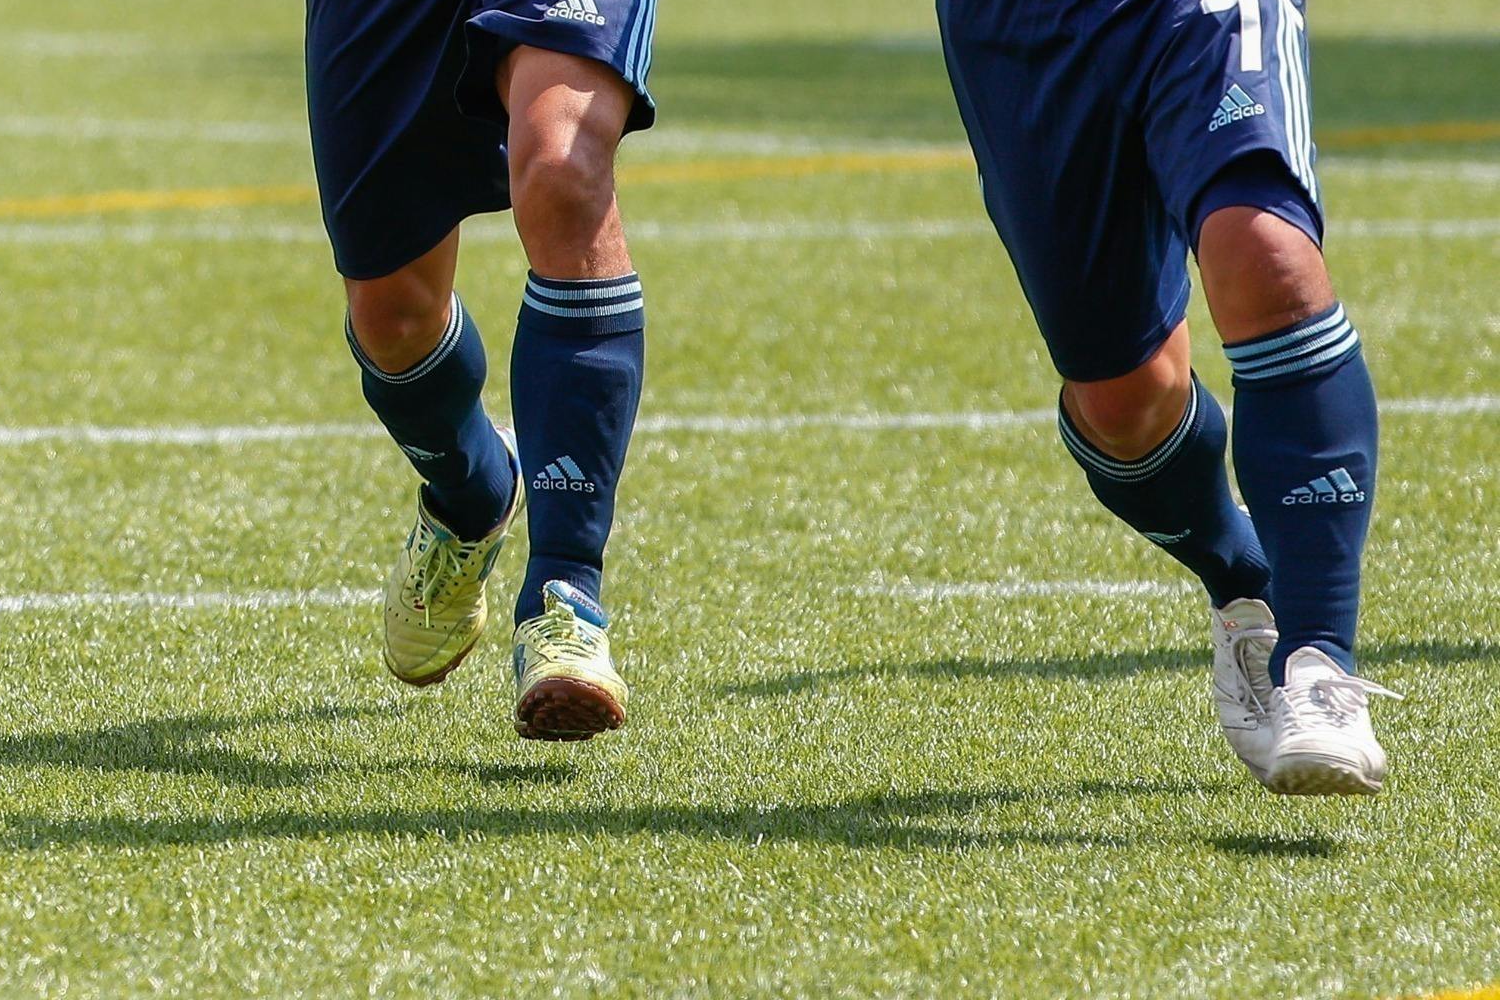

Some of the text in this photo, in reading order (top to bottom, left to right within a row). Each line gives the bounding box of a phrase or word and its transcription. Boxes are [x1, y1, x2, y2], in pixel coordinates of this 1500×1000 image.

[546, 6, 606, 26] adidas
[1208, 103, 1267, 132] adidas
[532, 478, 596, 494] adidas
[1281, 491, 1366, 506] adidas
